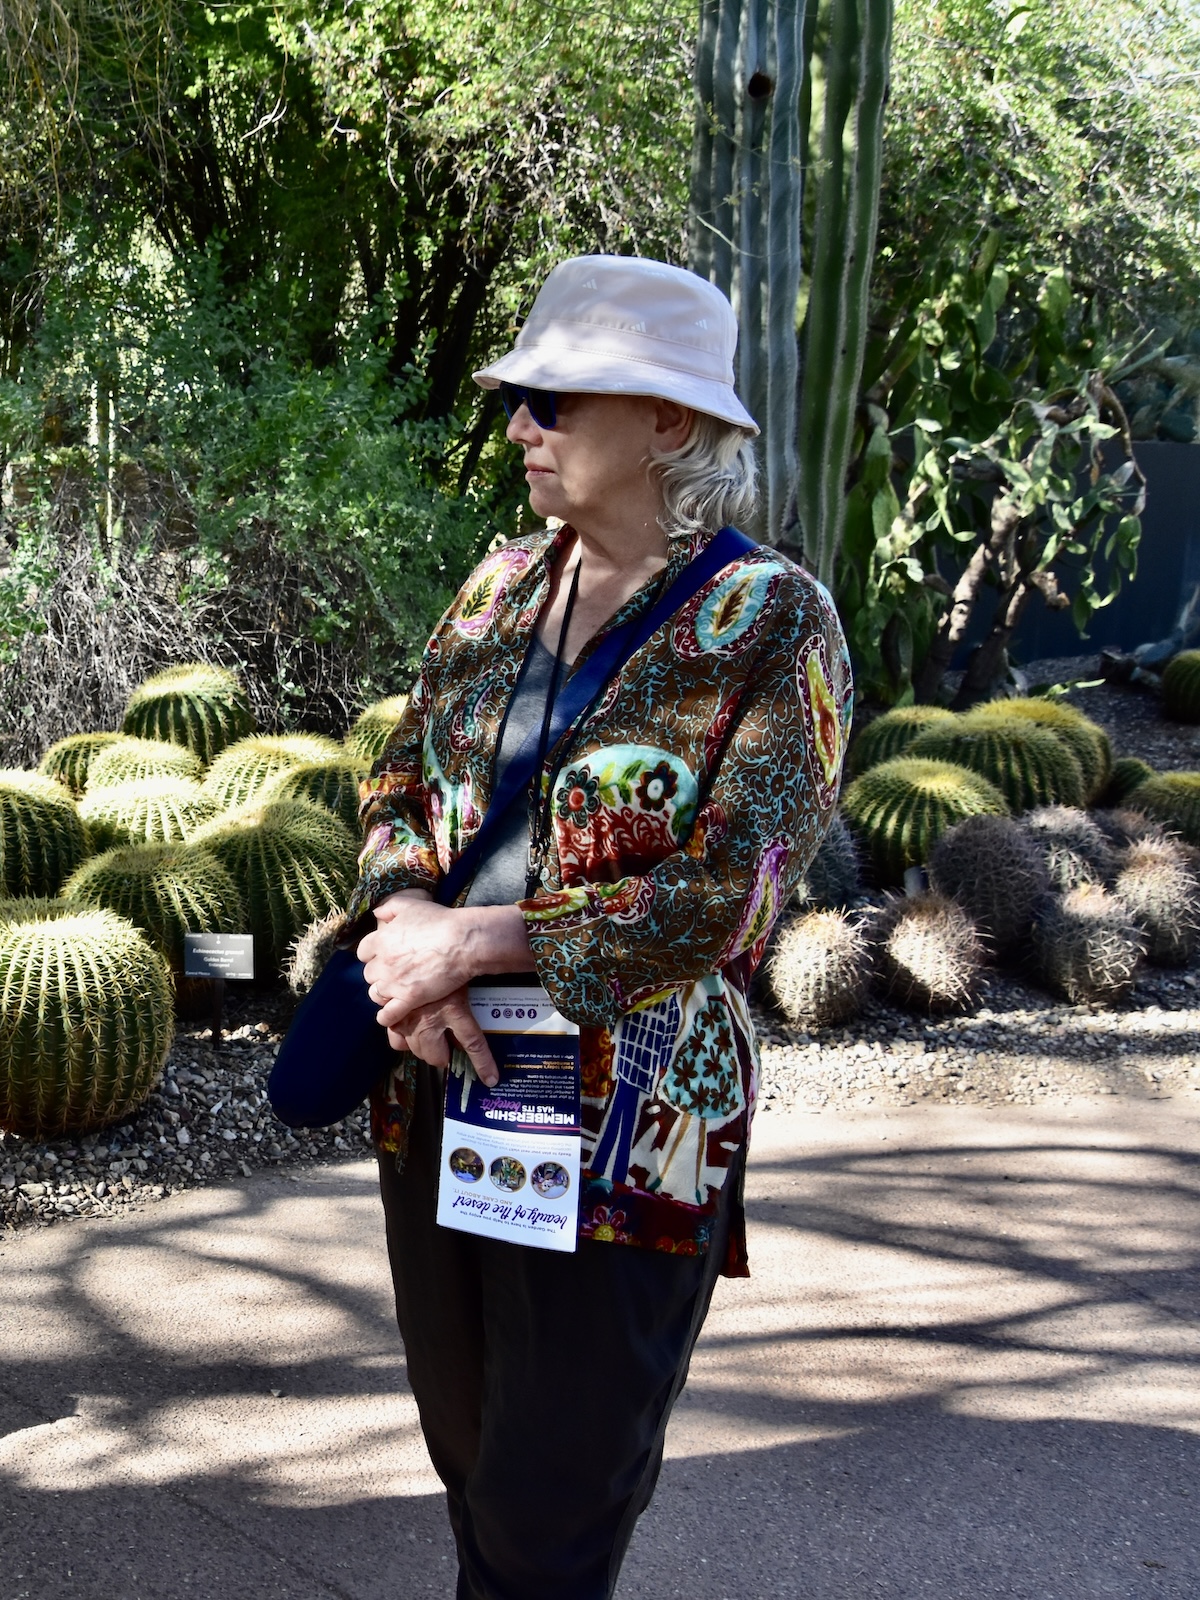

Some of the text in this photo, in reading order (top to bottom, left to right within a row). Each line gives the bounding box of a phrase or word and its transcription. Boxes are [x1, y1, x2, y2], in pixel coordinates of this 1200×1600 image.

[522, 1105, 535, 1113] ITS
[536, 1105, 554, 1113] HAS
[485, 1110, 574, 1125] MEMBERSHIP
[461, 1190, 480, 1198] ABOUT
[452, 1196, 567, 1229] beauty of the desert
